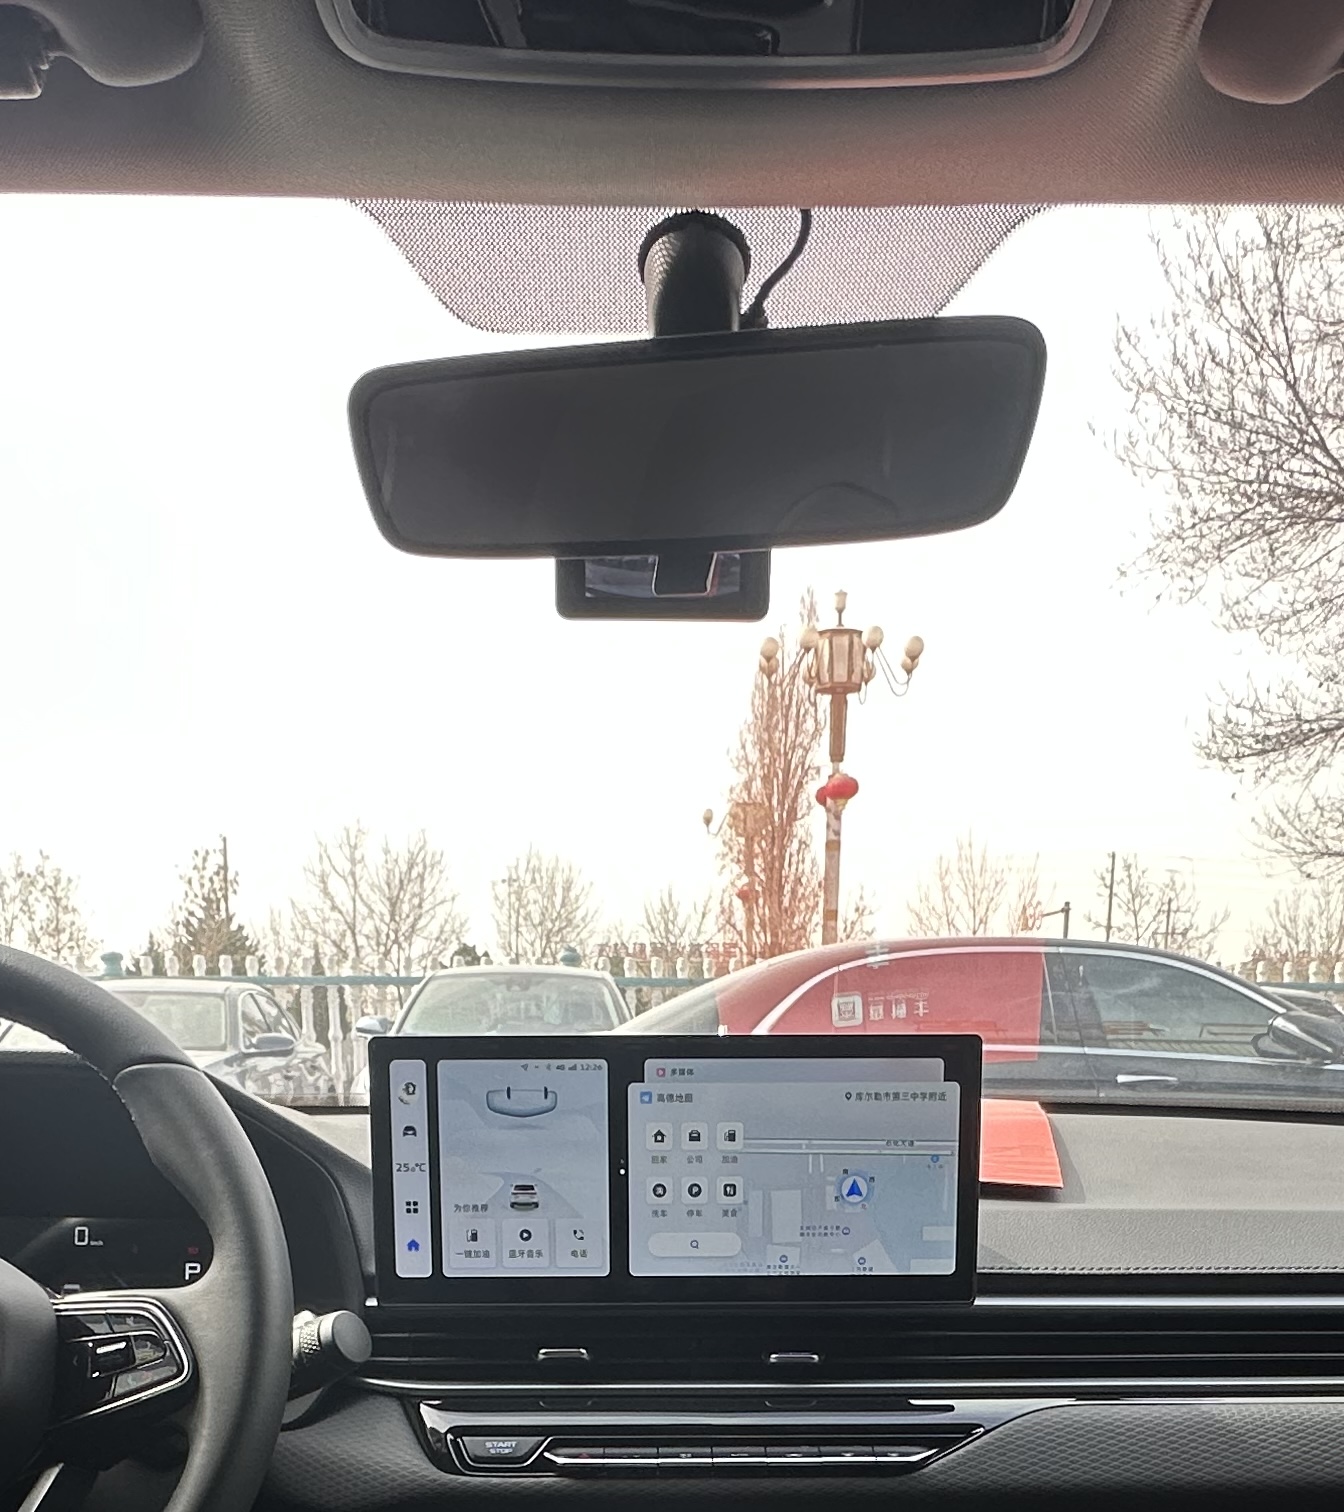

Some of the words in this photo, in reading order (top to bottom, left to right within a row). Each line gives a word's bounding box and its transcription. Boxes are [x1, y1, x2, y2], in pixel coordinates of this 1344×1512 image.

[580, 1063, 603, 1071] 12:26
[670, 1067, 694, 1076] 多媒体
[656, 1093, 693, 1103] 高德地图
[855, 1091, 947, 1101] 库尔勒市第三中学附近
[687, 1155, 703, 1164] 公司
[722, 1155, 738, 1164] 加油
[453, 1203, 488, 1213] 为你推荐
[722, 1208, 737, 1218] 美食
[651, 1209, 667, 1218] 洗车
[686, 1209, 702, 1218] 停车
[74, 1226, 89, 1246] 0
[456, 1249, 490, 1259] 一键加油
[508, 1249, 544, 1259] 蓝牙音乐
[570, 1249, 588, 1258] 电话
[184, 1262, 201, 1281] P
